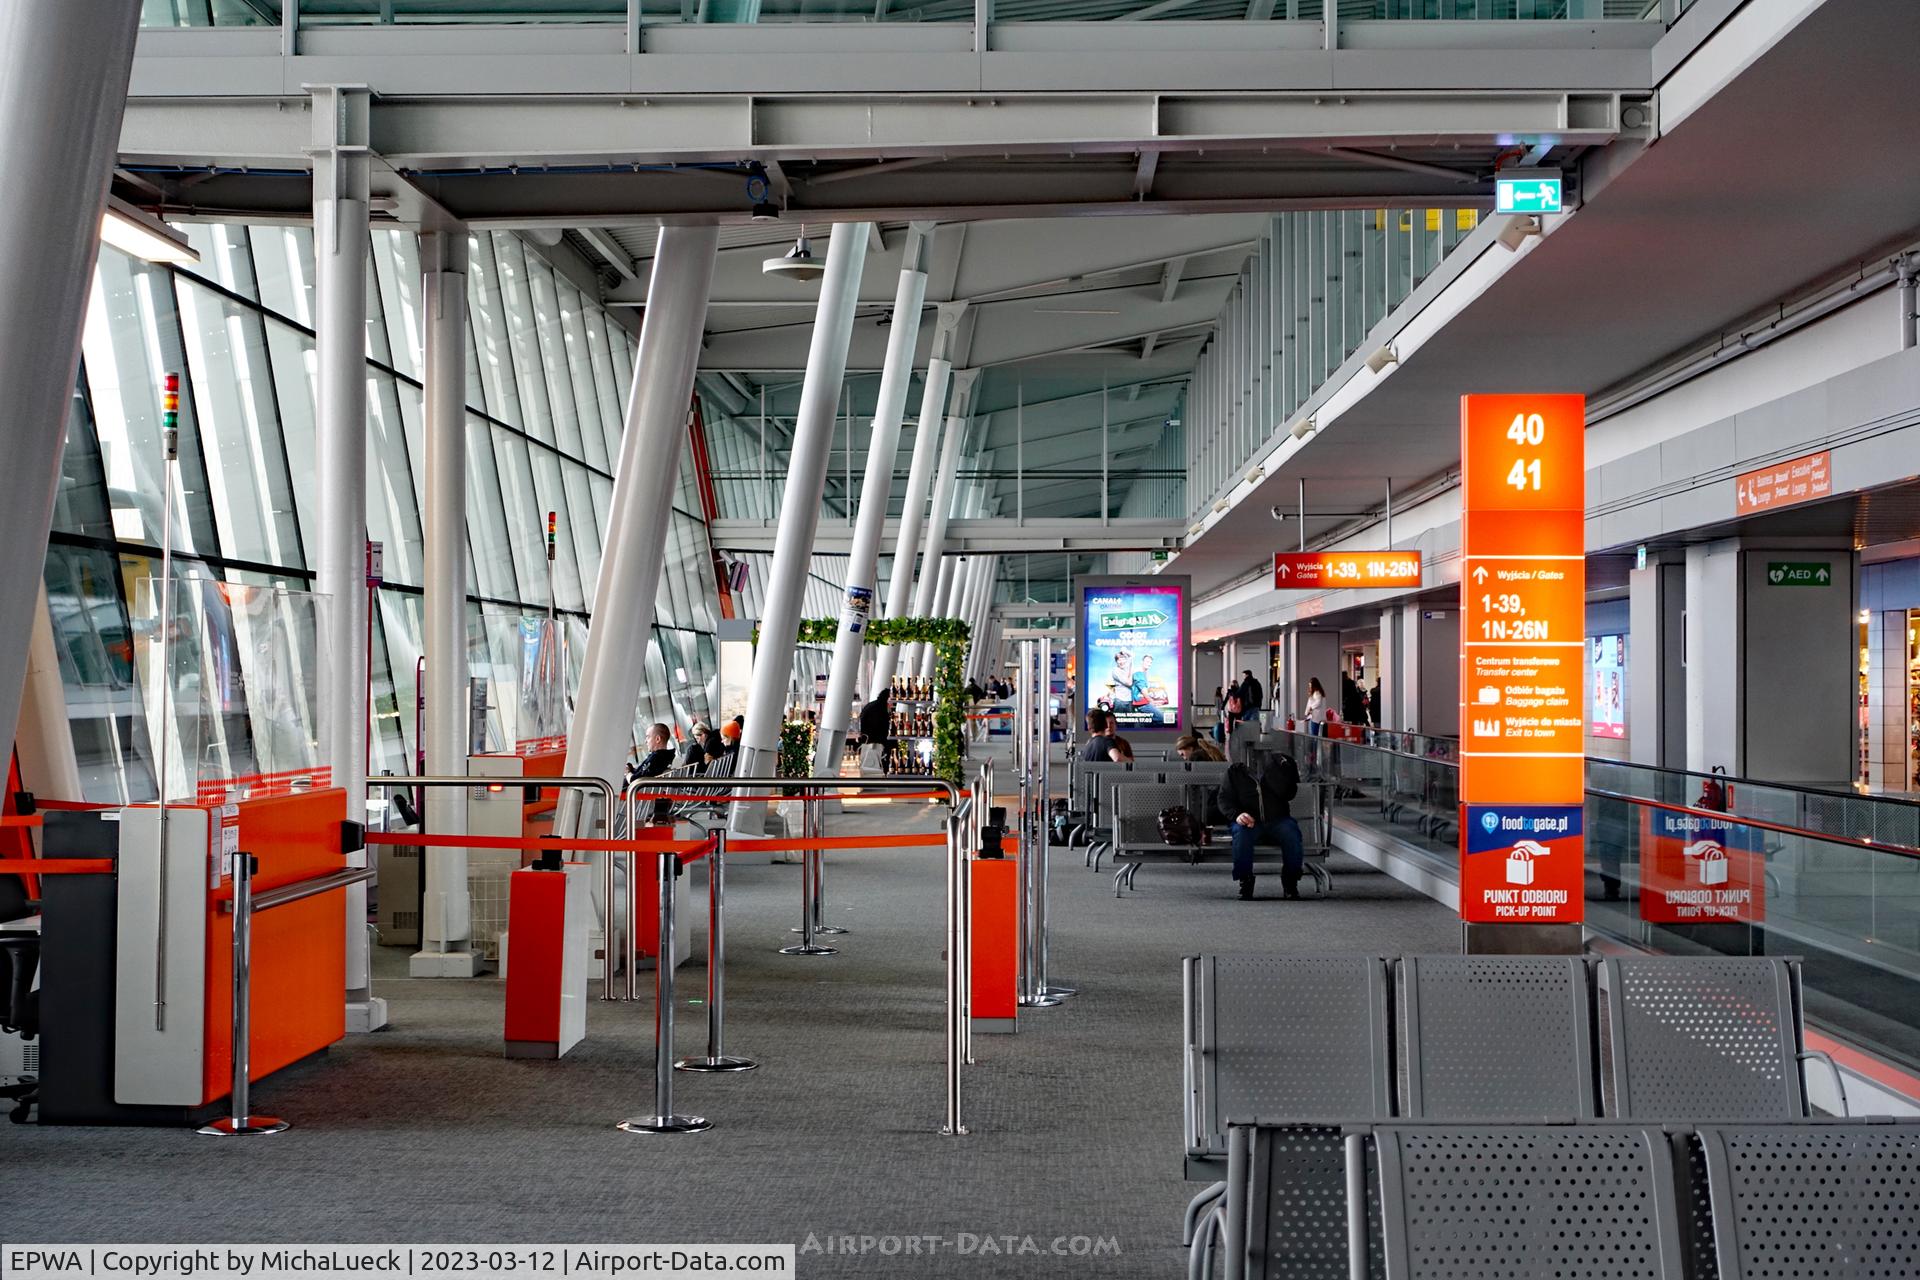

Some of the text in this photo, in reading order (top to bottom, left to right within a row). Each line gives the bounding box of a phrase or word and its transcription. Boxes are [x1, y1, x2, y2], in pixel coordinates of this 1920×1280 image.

[1507, 413, 1544, 445] 40
[1507, 458, 1542, 490] 41
[1296, 560, 1419, 580] Wyjścia 1-39, 1N-26N
[1497, 570, 1531, 581] Wyjścia
[1537, 570, 1564, 580] Gates
[1788, 570, 1811, 579] AED
[1482, 594, 1526, 616] 1-39,
[1482, 620, 1549, 639] 1N-26N
[1476, 657, 1560, 666] Centrum transferowe
[1476, 668, 1539, 676] Transfer center
[1505, 686, 1534, 695] Odbiór
[1505, 697, 1569, 708] Baggage claim
[1505, 717, 1539, 727] Wyjście
[1554, 718, 1582, 726] miasta
[1505, 728, 1556, 737] Exit to town
[1502, 816, 1568, 833] foodtogate.pl
[1484, 890, 1568, 904] PUNKT ODBIORU
[1496, 905, 1557, 917] PICK-UP POINT
